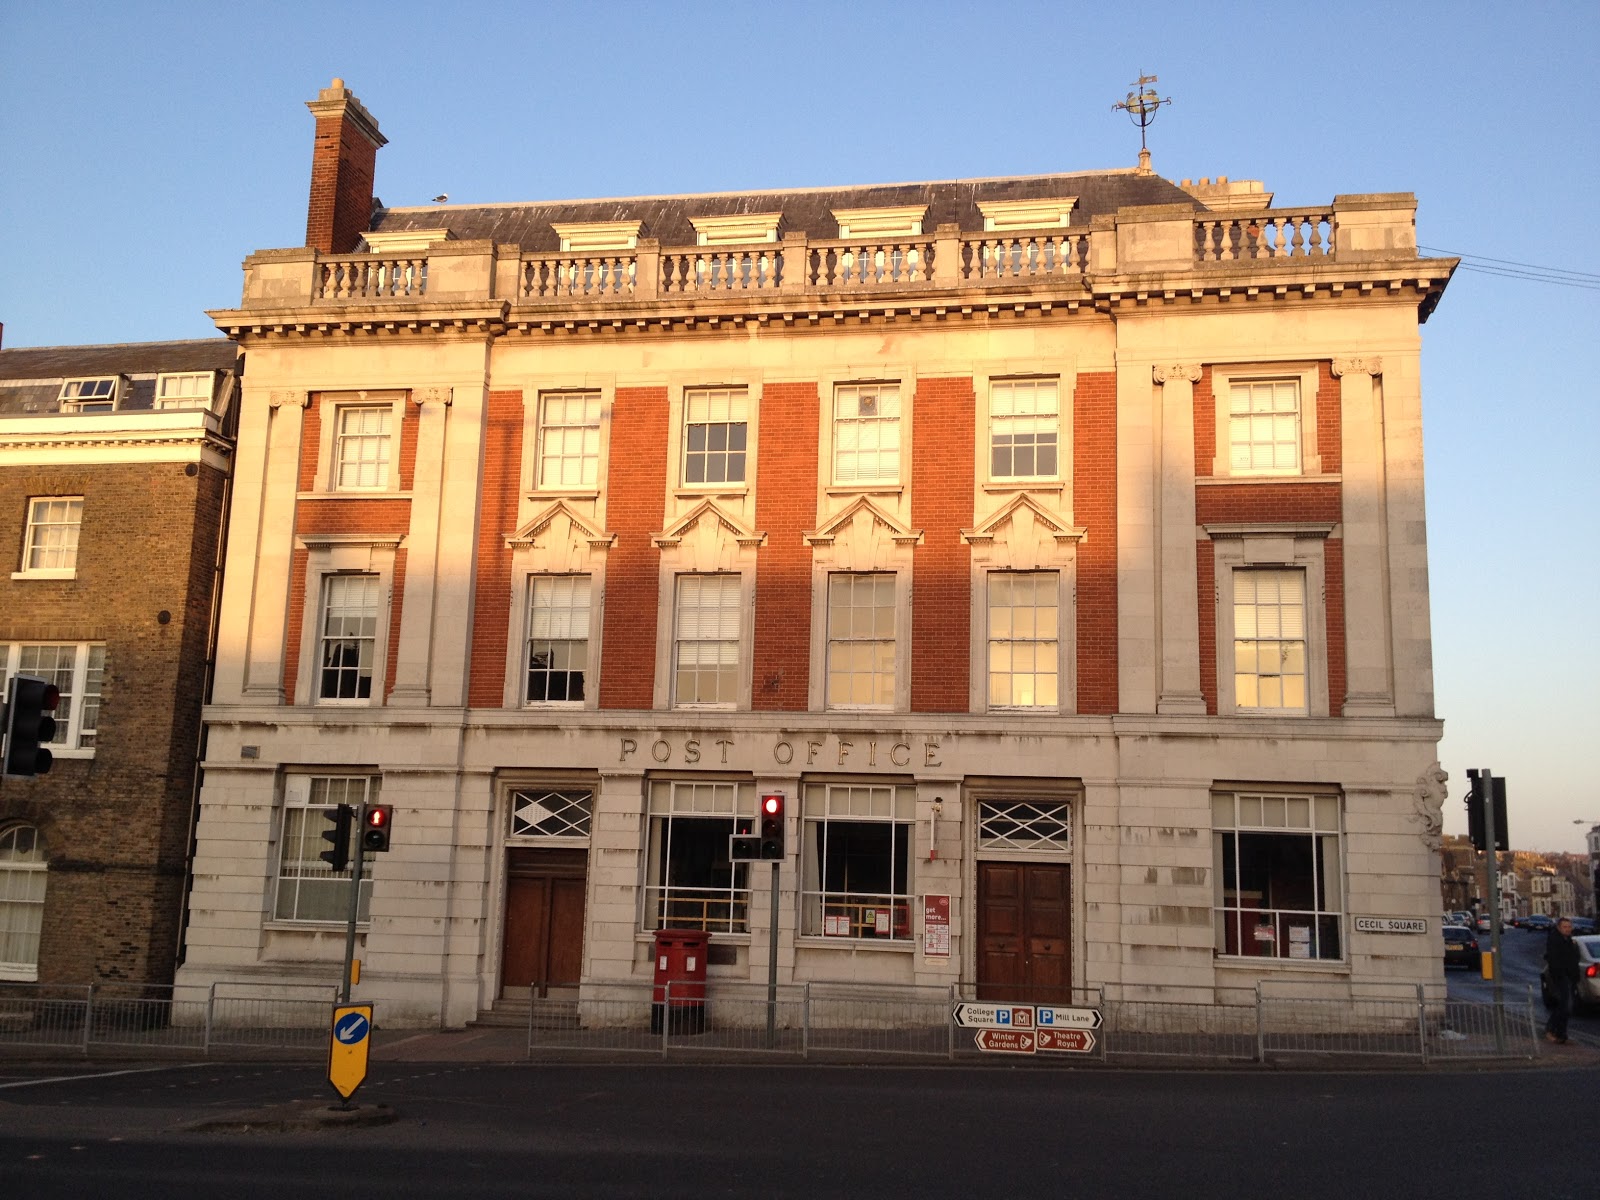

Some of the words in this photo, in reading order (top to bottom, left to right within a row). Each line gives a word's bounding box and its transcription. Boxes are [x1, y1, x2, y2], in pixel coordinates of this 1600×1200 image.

[620, 738, 734, 763] POST
[773, 740, 943, 767] OFFICE
[1358, 920, 1384, 929] CECIL
[1388, 921, 1423, 930] SQUARE
[967, 1008, 994, 1016] College
[1042, 1010, 1052, 1023] P
[968, 1015, 994, 1024] Square
[999, 1011, 1009, 1023] P
[1055, 1013, 1069, 1021] Mill
[1072, 1014, 1090, 1022] Lane
[991, 1032, 1015, 1041] Winter
[1053, 1031, 1081, 1040] Theatre
[988, 1040, 1019, 1049] Gardens
[1057, 1039, 1078, 1049] Royal
